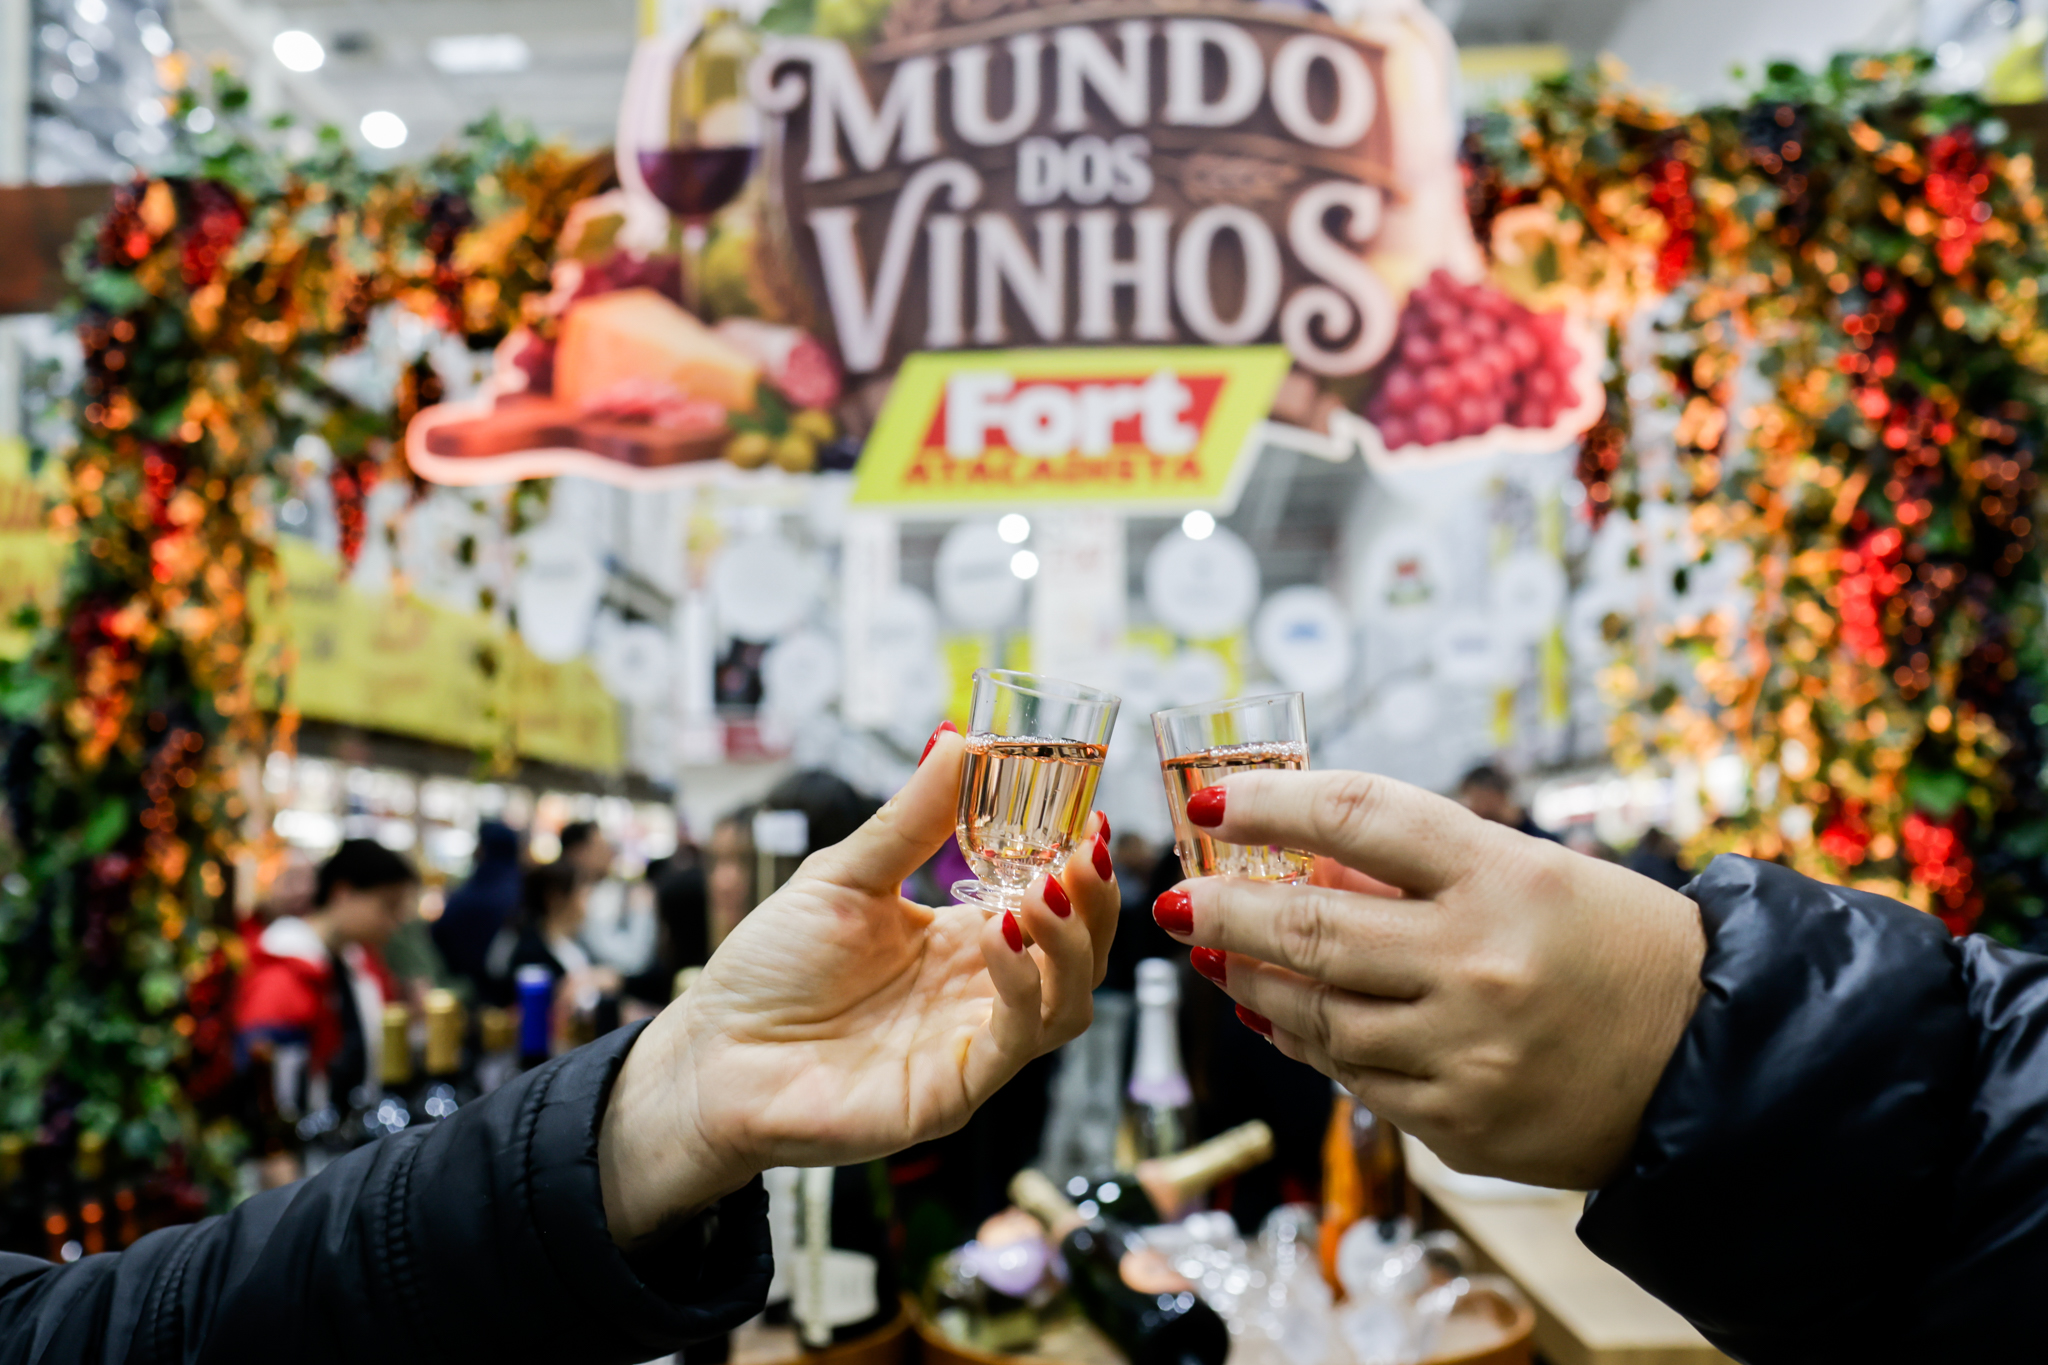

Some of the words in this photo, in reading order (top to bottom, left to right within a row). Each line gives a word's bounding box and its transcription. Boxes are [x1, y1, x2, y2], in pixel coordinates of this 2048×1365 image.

[752, 20, 1378, 180] MUNDO
[1018, 137, 1154, 205] DOS
[812, 162, 1399, 374] VINHOS
[946, 370, 1198, 458] Fort
